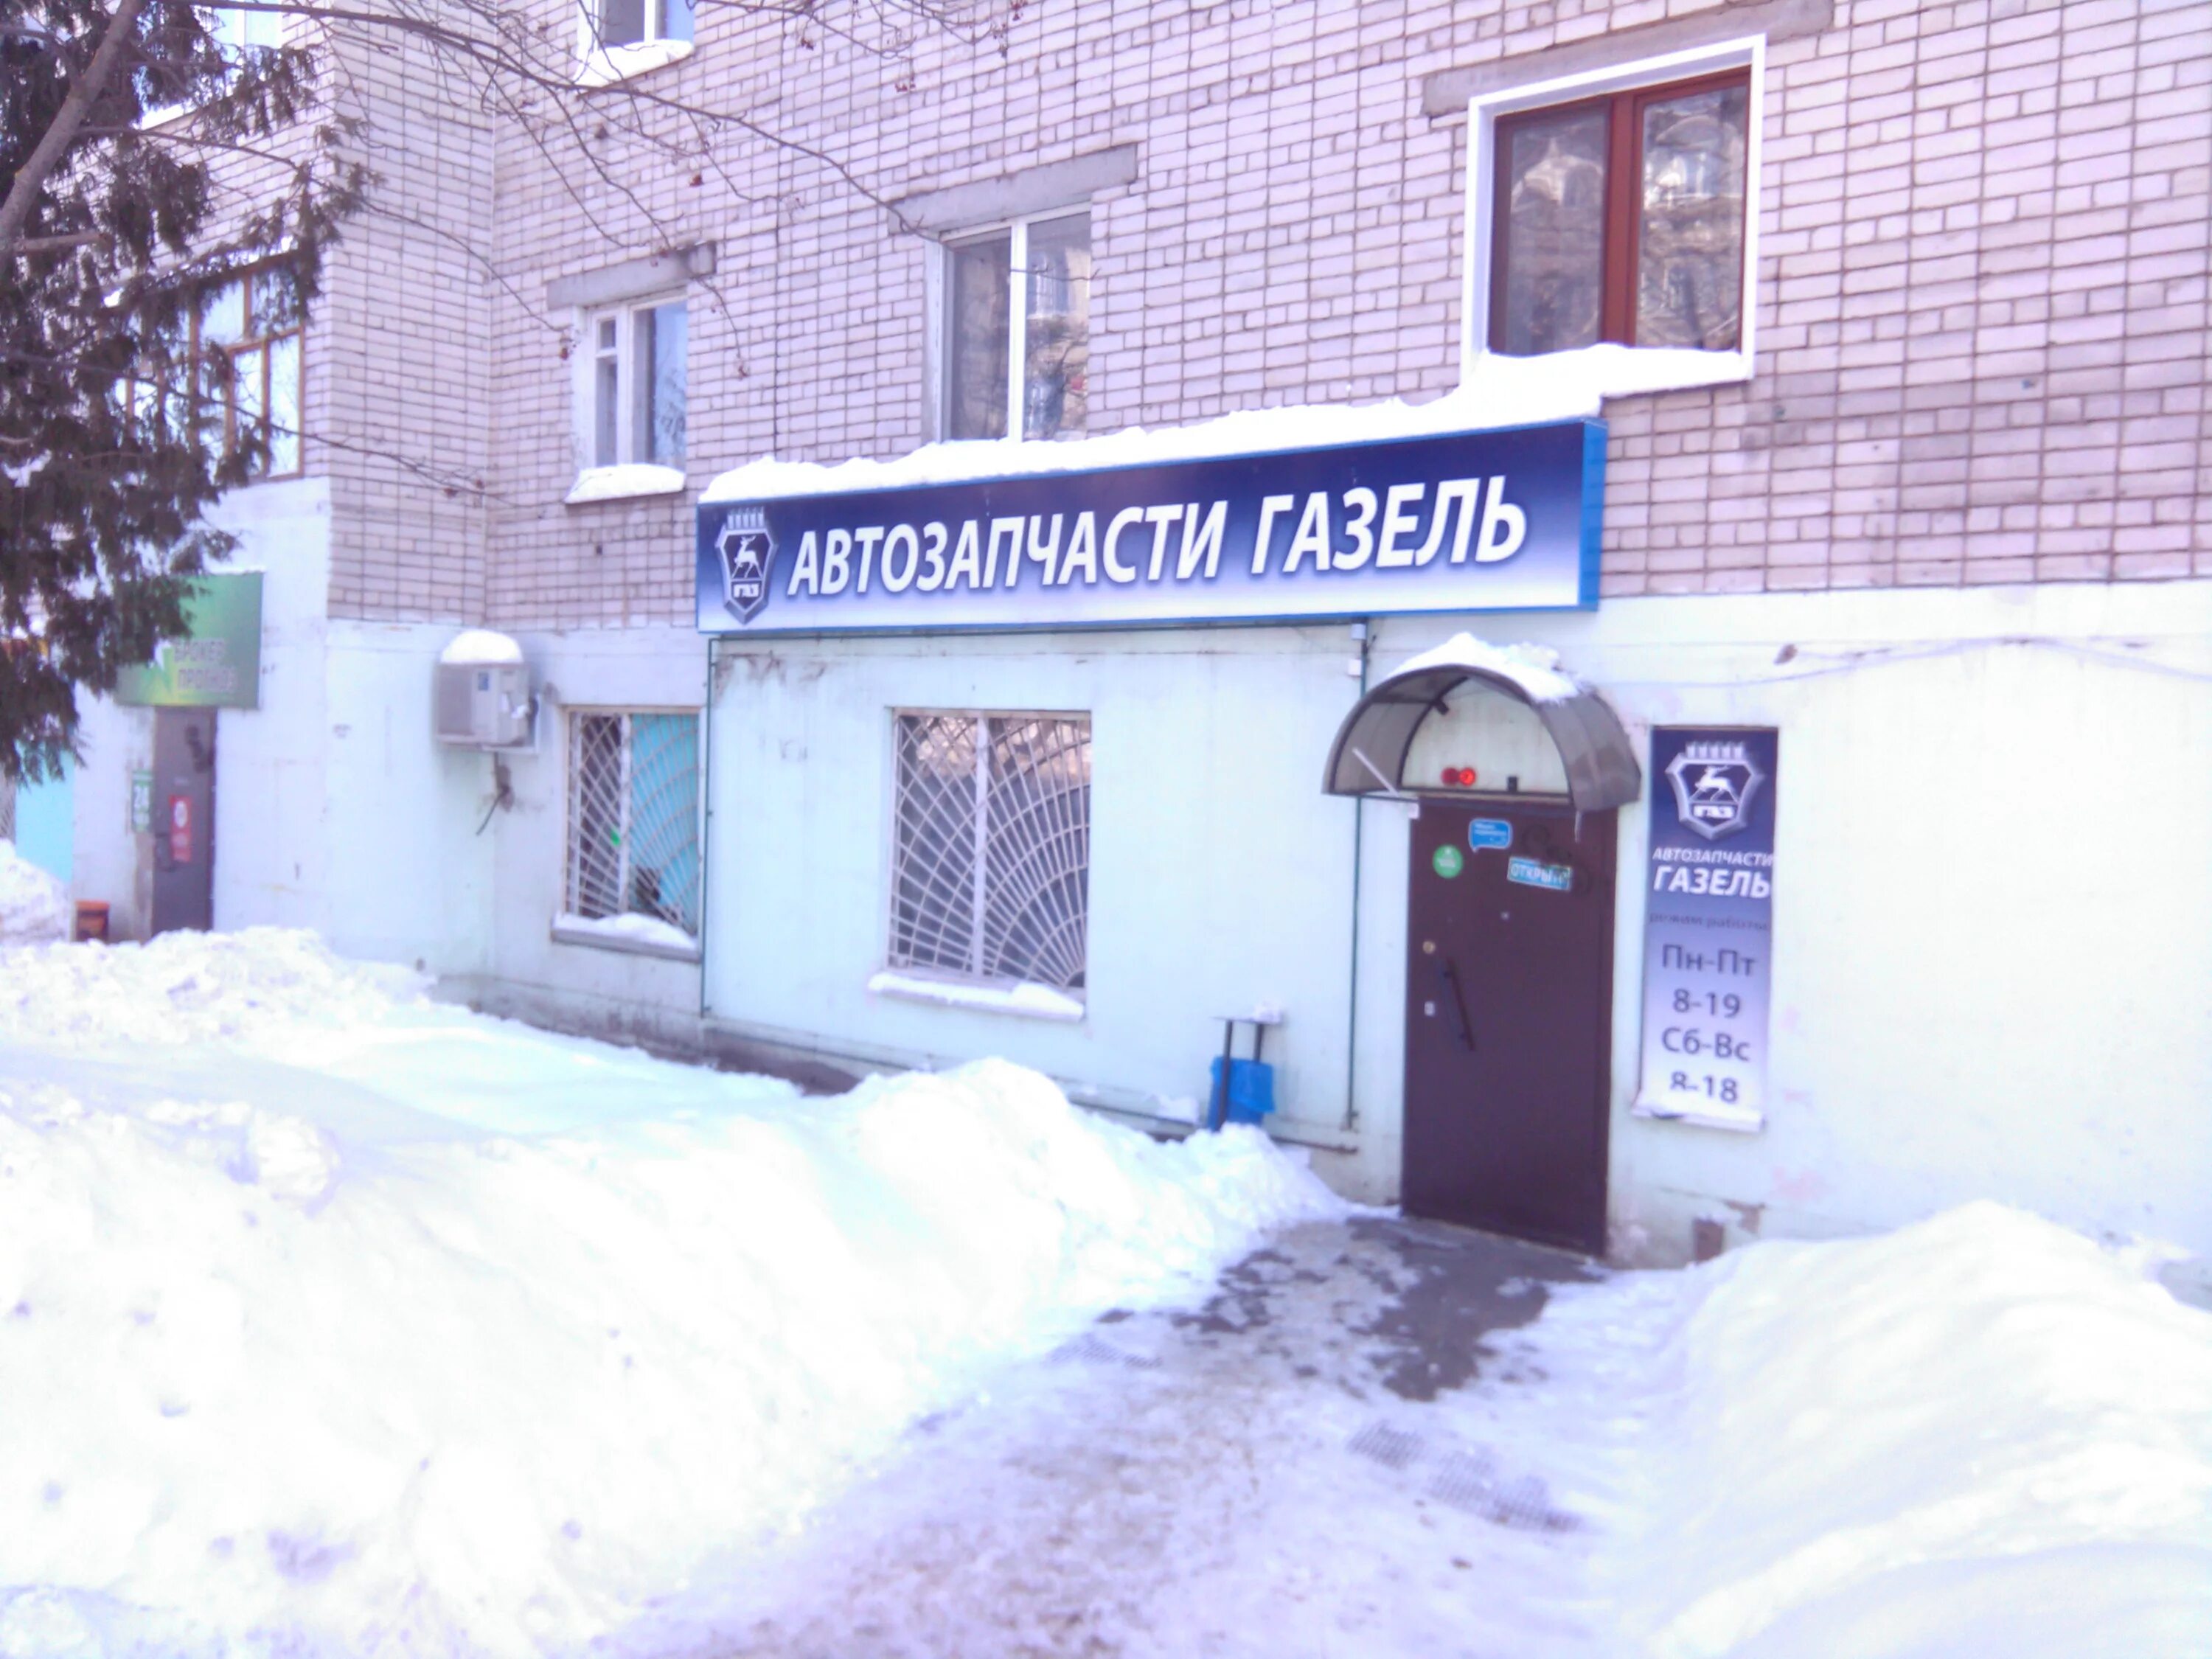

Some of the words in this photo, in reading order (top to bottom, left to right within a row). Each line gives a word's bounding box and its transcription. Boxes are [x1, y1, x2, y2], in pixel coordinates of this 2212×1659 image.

[787, 501, 1228, 596] АВТОЗАПЧАСТИ
[1251, 476, 1526, 574] ГАЗЕЛЬ
[1694, 805, 1734, 818] ГАЗ
[1652, 847, 1774, 867] АВТОЗАПЧАСТИ
[1653, 866, 1770, 898] ГАЗЕЛЬ
[1662, 944, 1756, 976] Пн-Пт
[1673, 988, 1742, 1018] 8-19
[1661, 1026, 1751, 1062] Сб-Вс
[1670, 1071, 1738, 1104] 8-18
